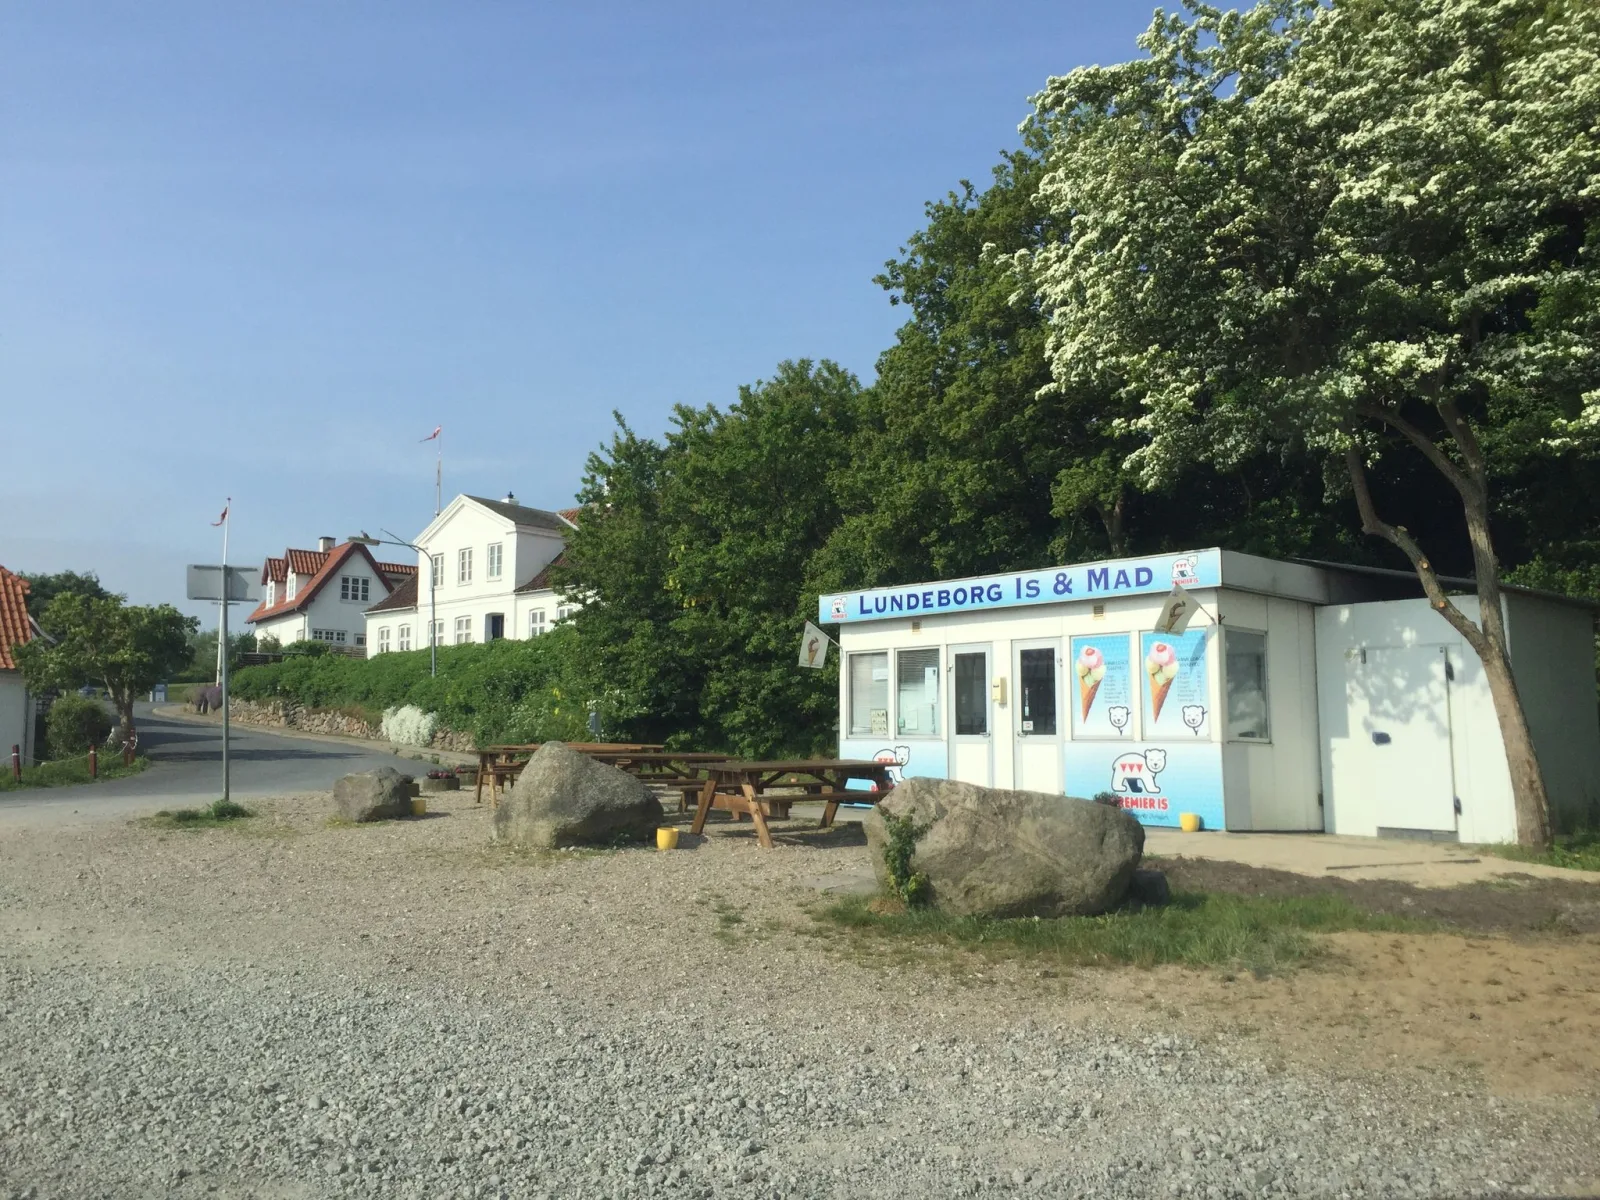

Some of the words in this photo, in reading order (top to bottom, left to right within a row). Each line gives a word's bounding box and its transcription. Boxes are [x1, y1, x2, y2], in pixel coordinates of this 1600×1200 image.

[859, 583, 1002, 615] LUNDEBORG
[1015, 577, 1041, 599] IS
[1053, 572, 1073, 595] &
[1087, 566, 1153, 592] MAD
[1117, 796, 1155, 809] REMIER
[1157, 797, 1168, 810] IS
